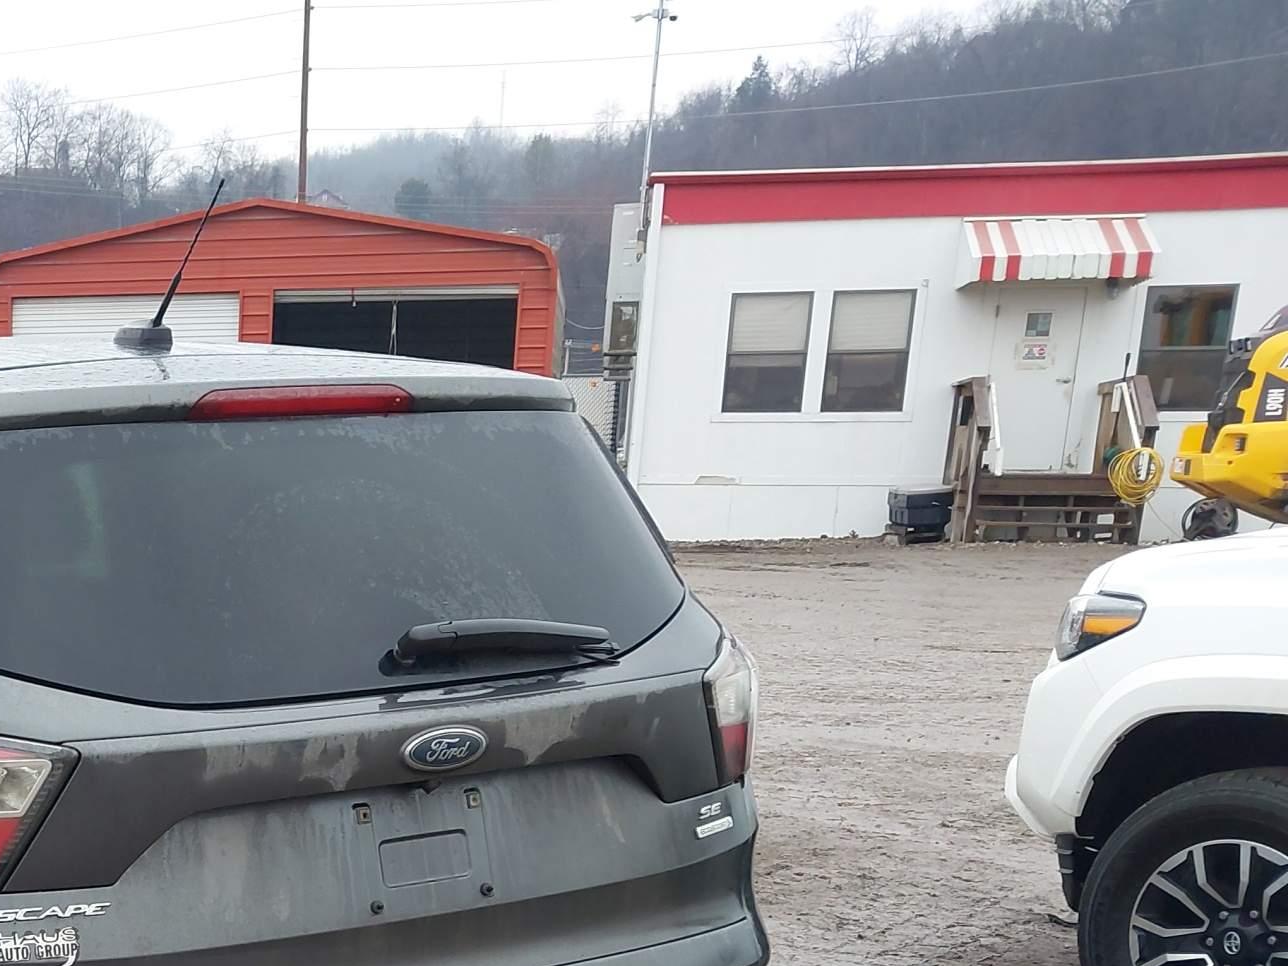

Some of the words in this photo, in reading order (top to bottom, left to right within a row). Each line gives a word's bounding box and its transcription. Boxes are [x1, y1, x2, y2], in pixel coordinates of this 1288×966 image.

[1265, 389, 1286, 416] L90H
[426, 738, 471, 762] Ford
[699, 802, 722, 820] SE
[36, 943, 79, 959] GROUP
